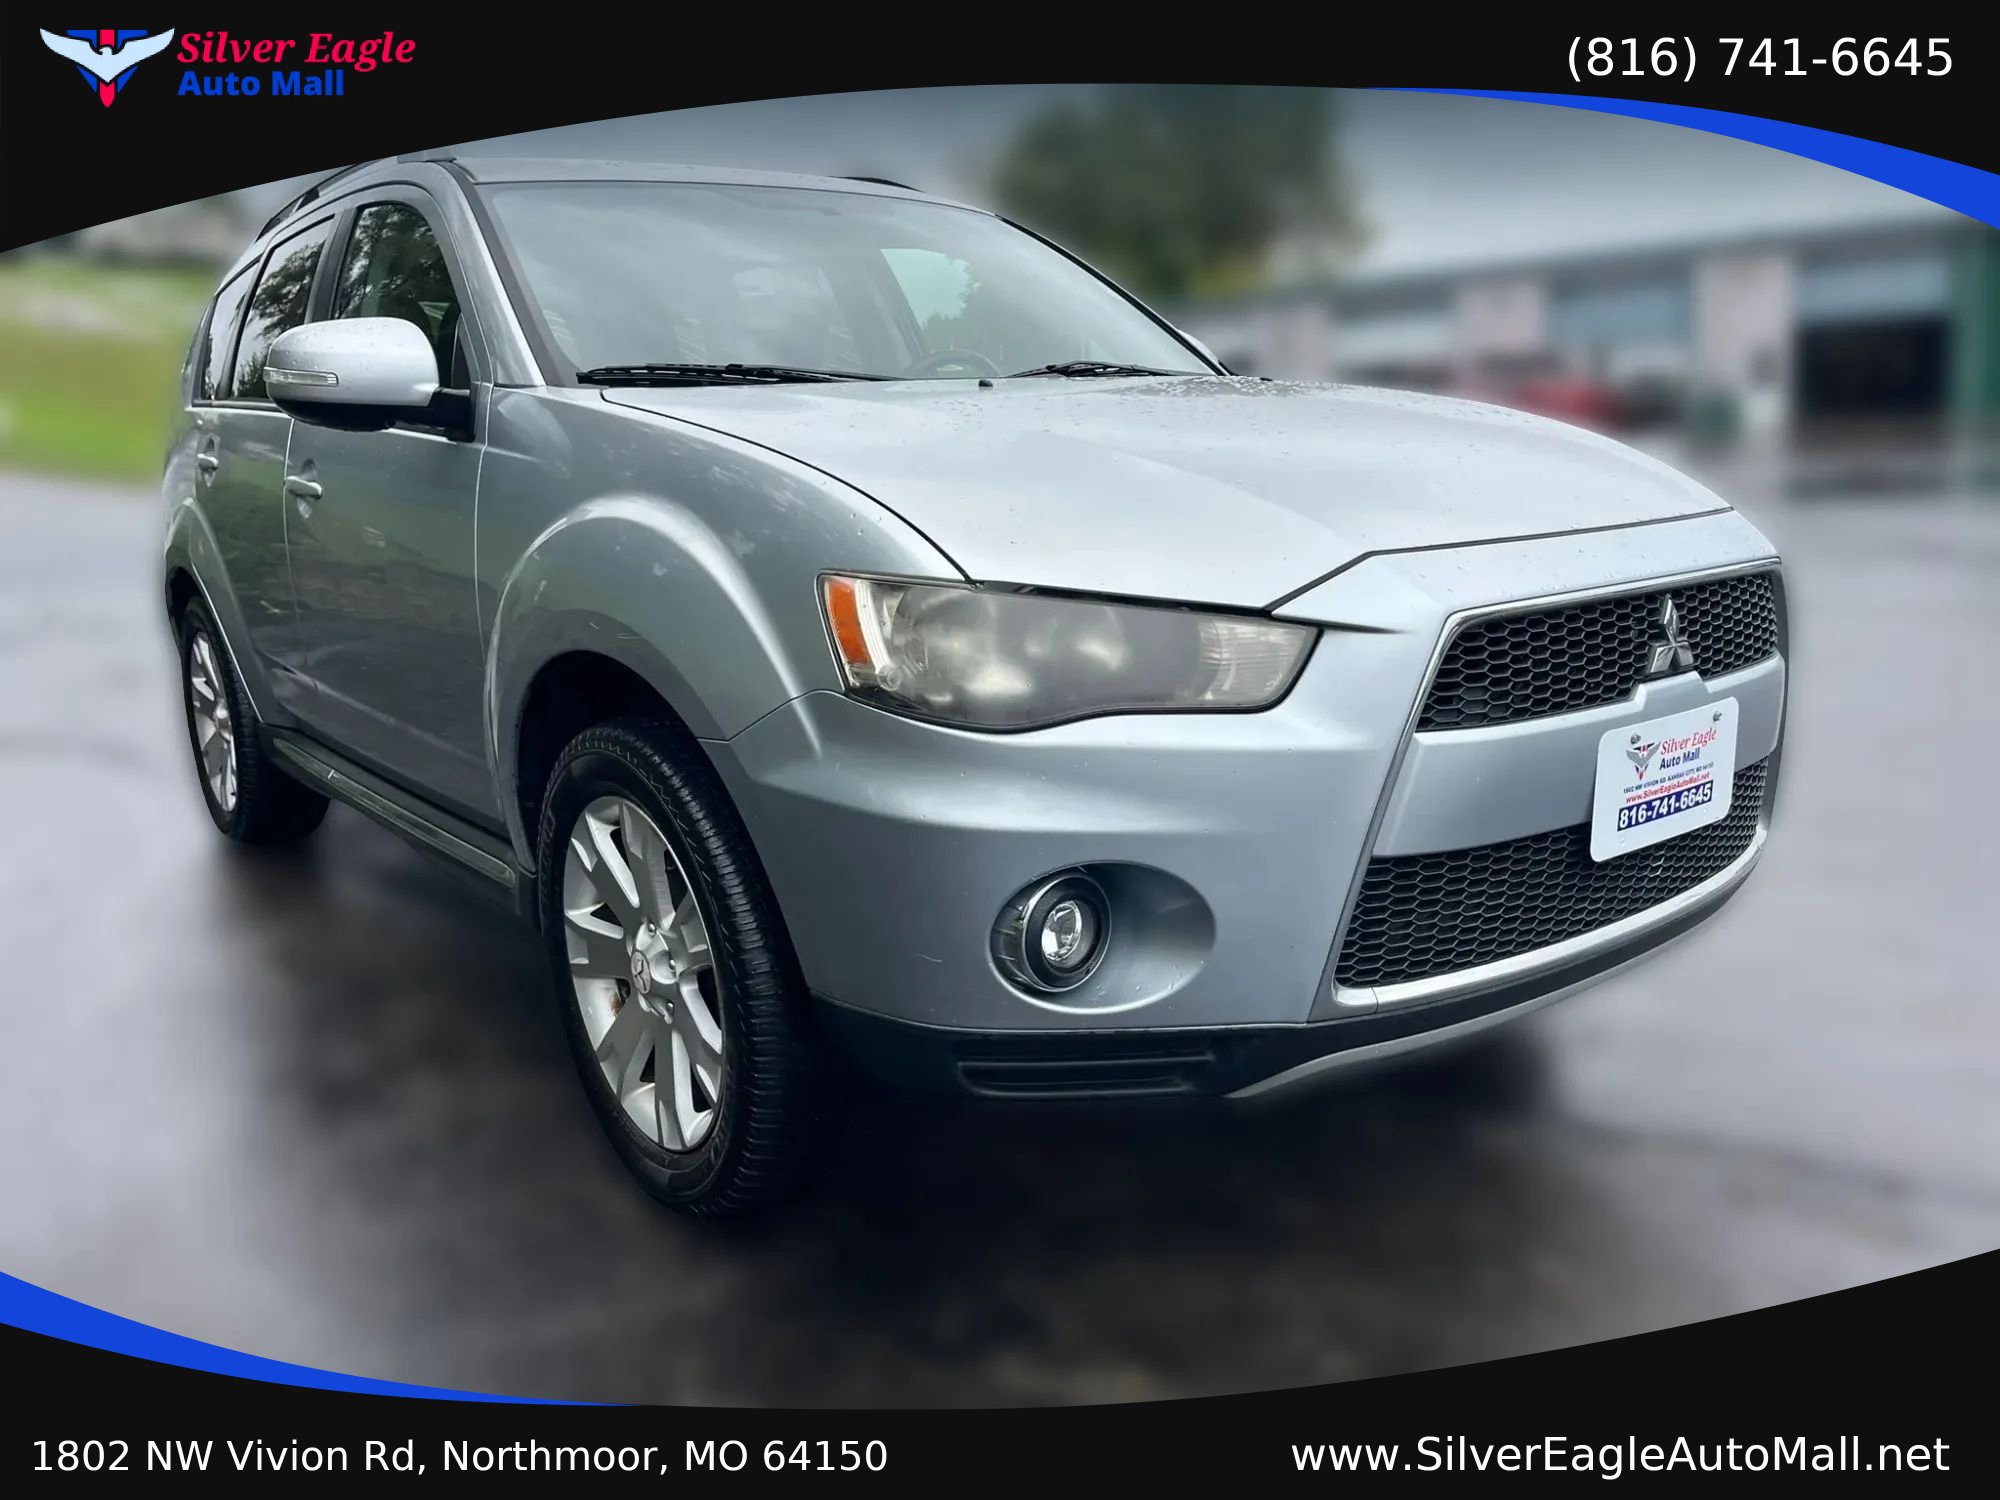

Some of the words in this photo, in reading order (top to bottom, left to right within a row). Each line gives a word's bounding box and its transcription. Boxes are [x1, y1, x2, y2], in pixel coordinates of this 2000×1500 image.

[1660, 738, 1690, 755] Silver
[1691, 727, 1717, 748] Eagle
[1659, 756, 1681, 770] Auto
[1682, 747, 1700, 763] Mall
[1619, 783, 1711, 829] 816-741-6645
